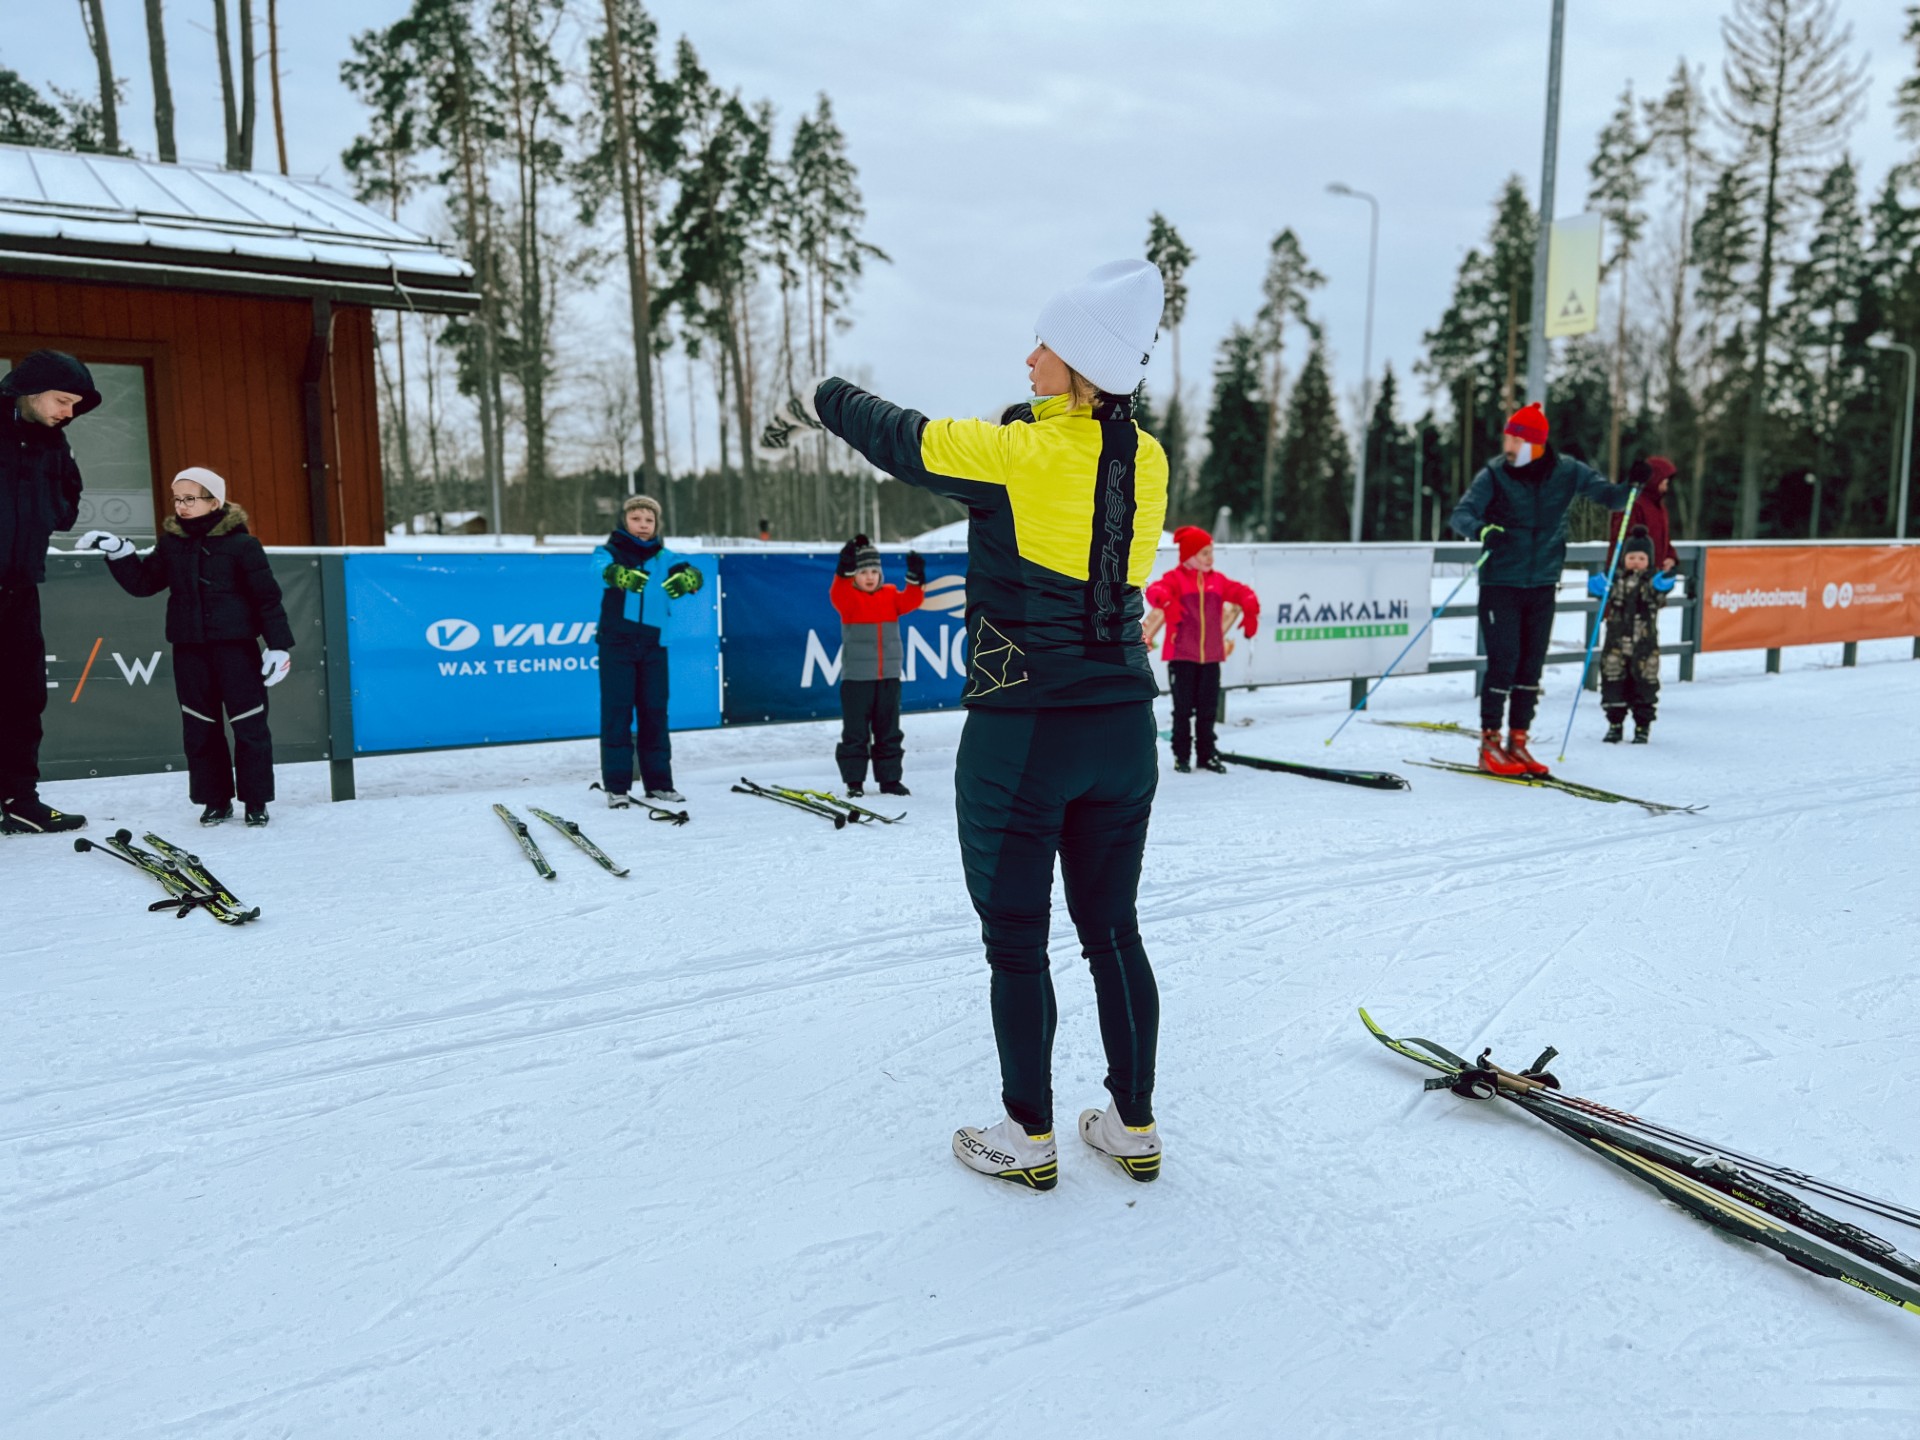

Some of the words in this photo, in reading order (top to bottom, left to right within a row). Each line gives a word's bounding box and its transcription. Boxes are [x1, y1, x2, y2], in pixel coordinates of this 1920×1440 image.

[438, 661, 487, 676] WAX
[956, 1129, 1016, 1168] FISCHER
[1841, 1274, 1902, 1306] FISCHER
